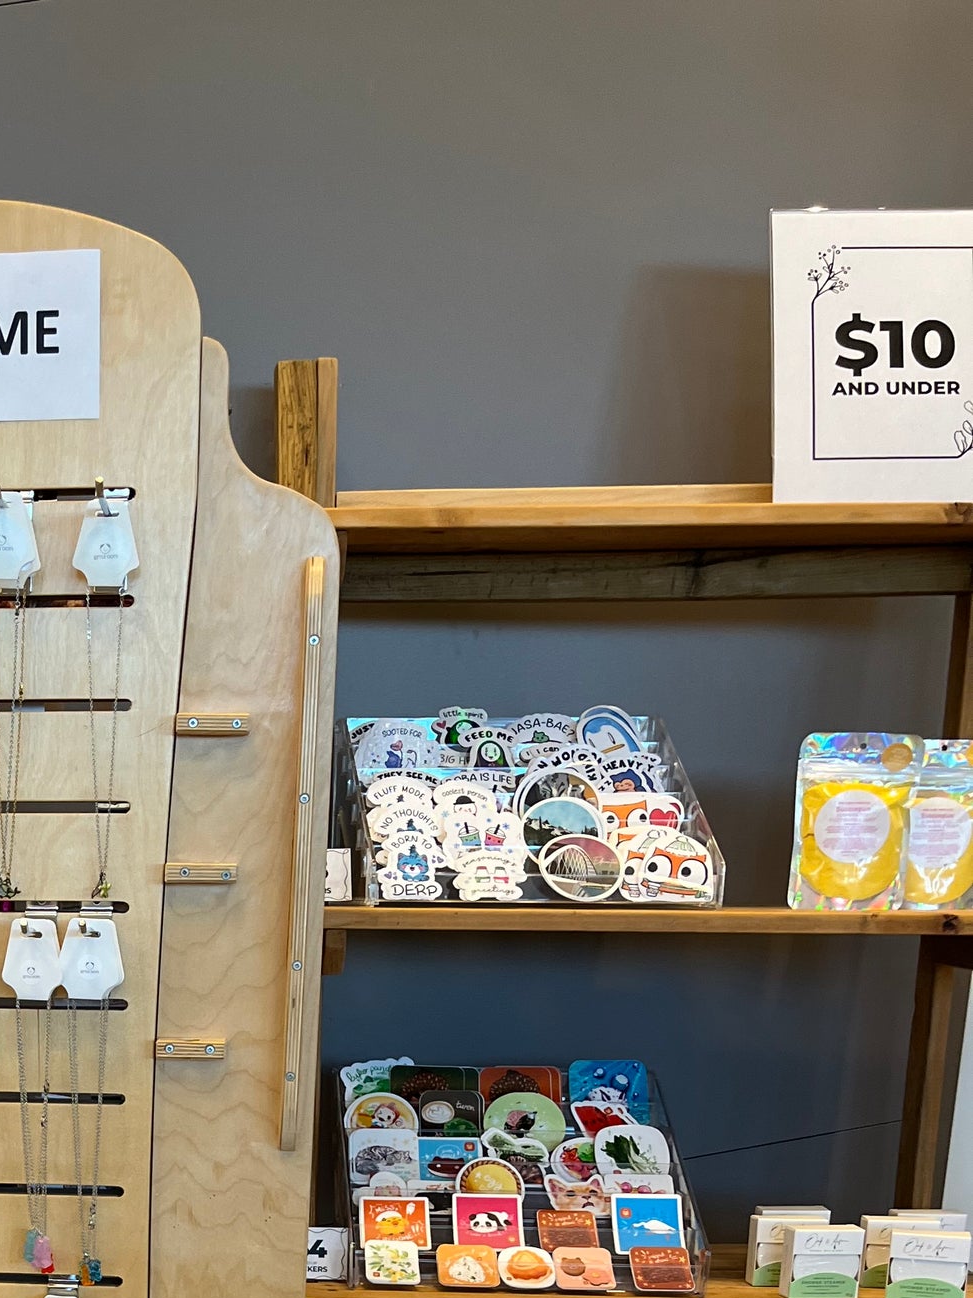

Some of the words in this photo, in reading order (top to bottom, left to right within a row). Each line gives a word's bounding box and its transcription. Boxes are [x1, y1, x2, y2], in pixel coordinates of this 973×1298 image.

[835, 313, 956, 377] $10
[832, 382, 879, 395] AND
[886, 381, 961, 395] UNDER
[442, 710, 461, 718] little
[511, 718, 575, 736] ASA-BAE?
[464, 730, 493, 742] FEED
[496, 731, 514, 743] ME
[602, 759, 643, 773] HEAVY
[377, 771, 402, 780] THEY
[406, 771, 423, 780] SEE
[480, 772, 489, 781] IS
[492, 773, 512, 785] LIFE
[373, 785, 397, 799] FLUFF
[402, 785, 425, 800] MODE
[380, 816, 393, 829] NO
[393, 808, 439, 831] THOUGHTS
[391, 835, 418, 848] BORN
[421, 838, 432, 849] TO
[391, 884, 438, 896] DERP
